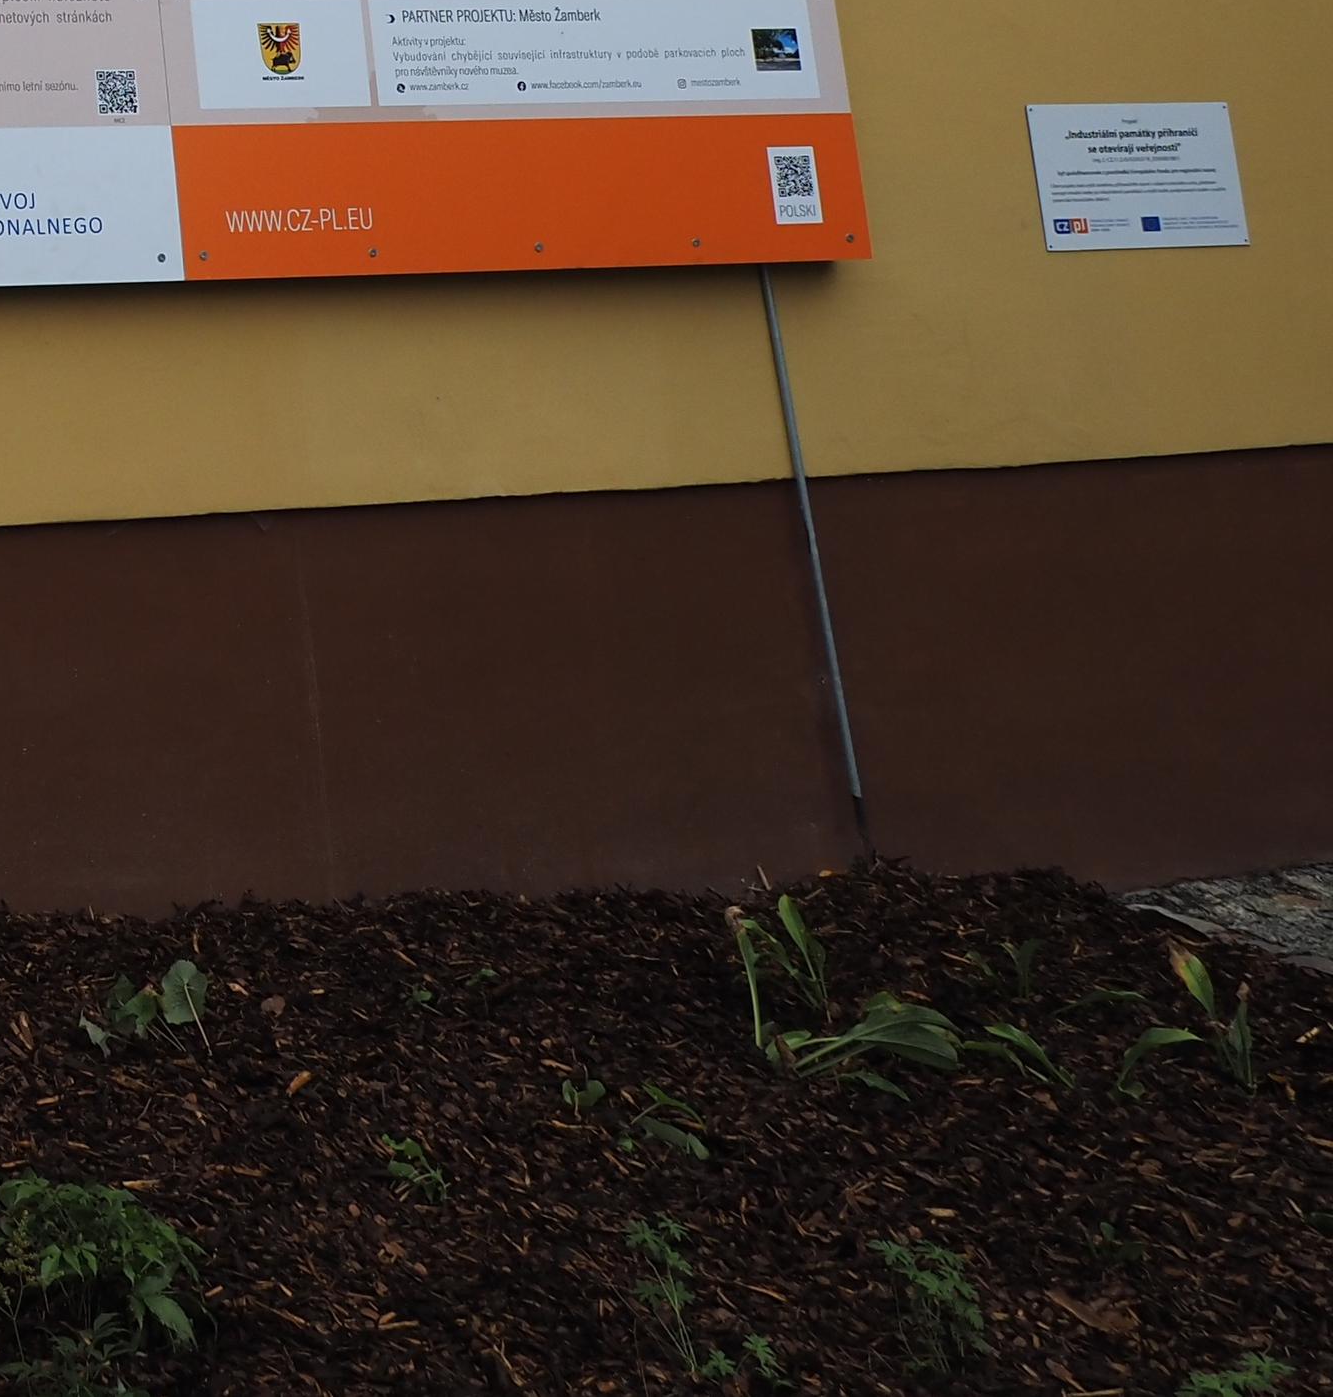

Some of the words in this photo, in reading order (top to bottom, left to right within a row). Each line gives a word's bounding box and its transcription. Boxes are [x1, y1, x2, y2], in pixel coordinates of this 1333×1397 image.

[402, 10, 453, 23] PARTNER
[456, 9, 516, 22] PROJEKTU:
[519, 9, 551, 22] Město
[554, 6, 600, 21] Žamberk
[779, 204, 817, 216] POLSKI
[225, 207, 372, 232] WWW.CZ-PL.EU
